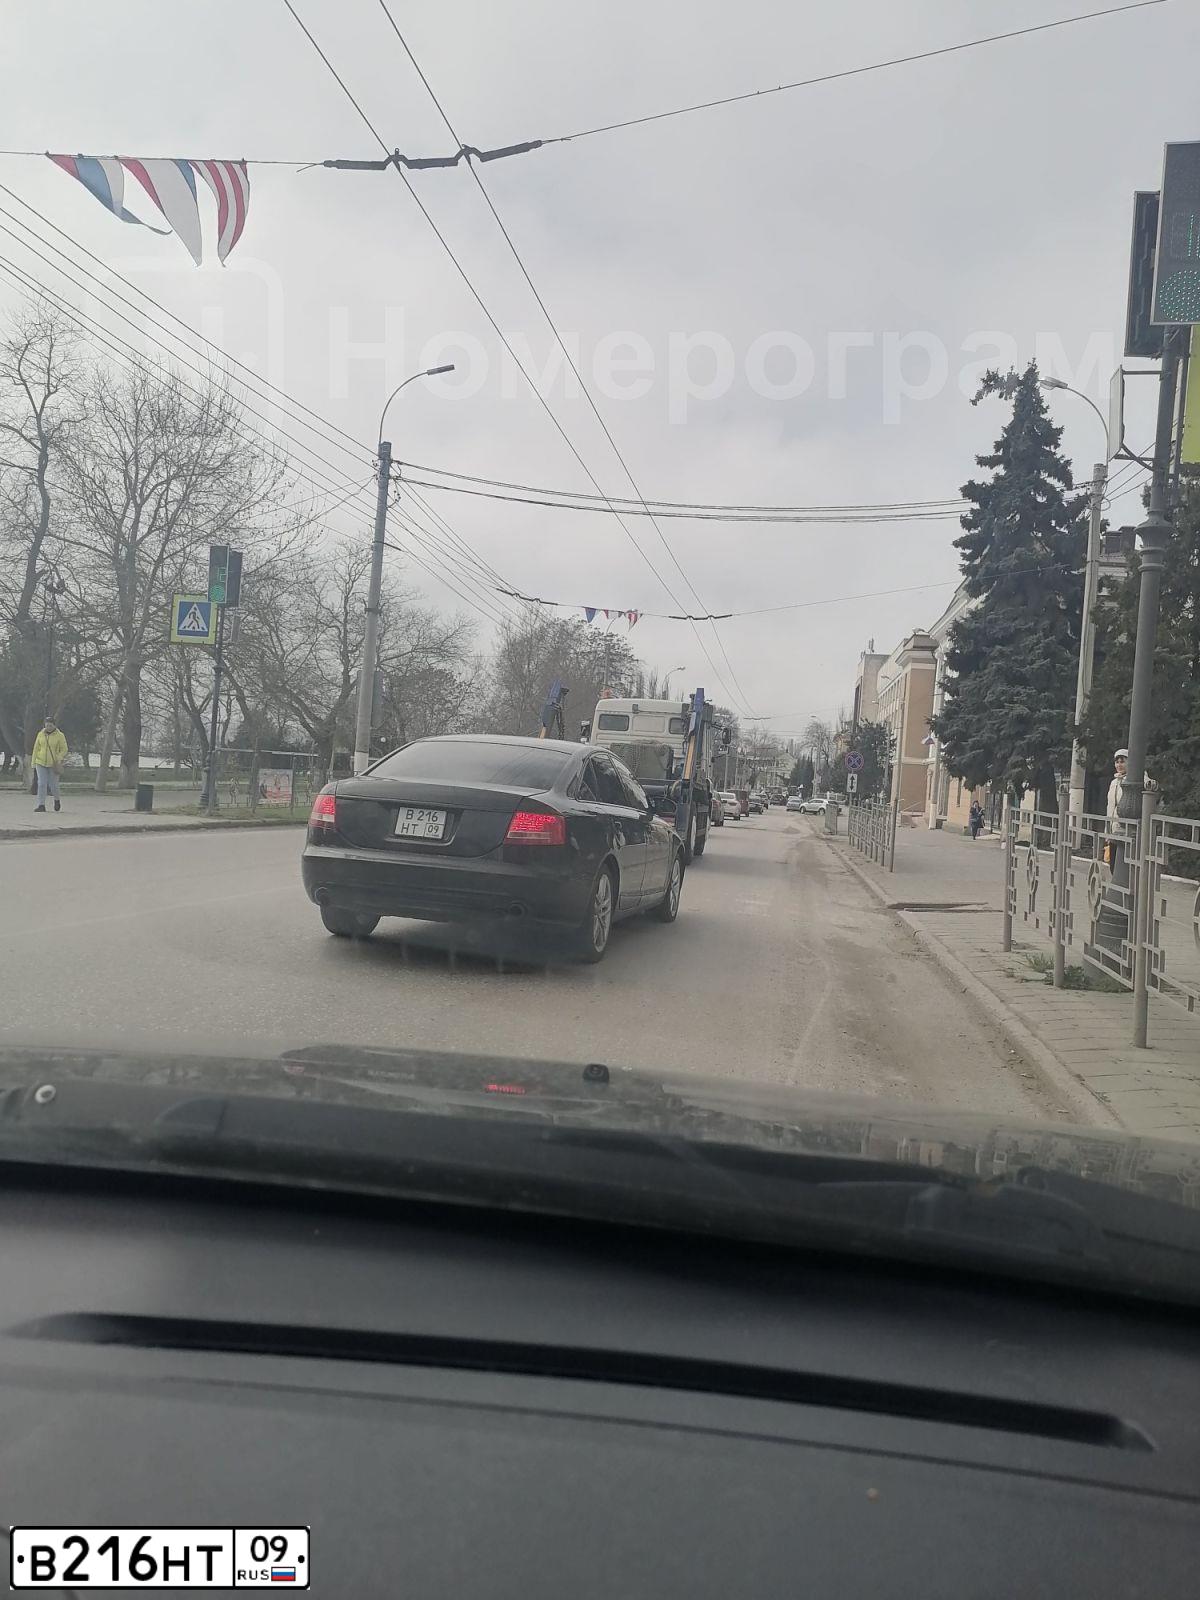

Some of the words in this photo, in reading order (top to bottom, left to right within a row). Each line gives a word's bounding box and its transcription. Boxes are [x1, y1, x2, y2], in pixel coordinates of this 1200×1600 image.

[406, 809, 414, 820] В
[417, 810, 438, 822] 216
[401, 822, 419, 834] НТ
[427, 825, 439, 834] 09
